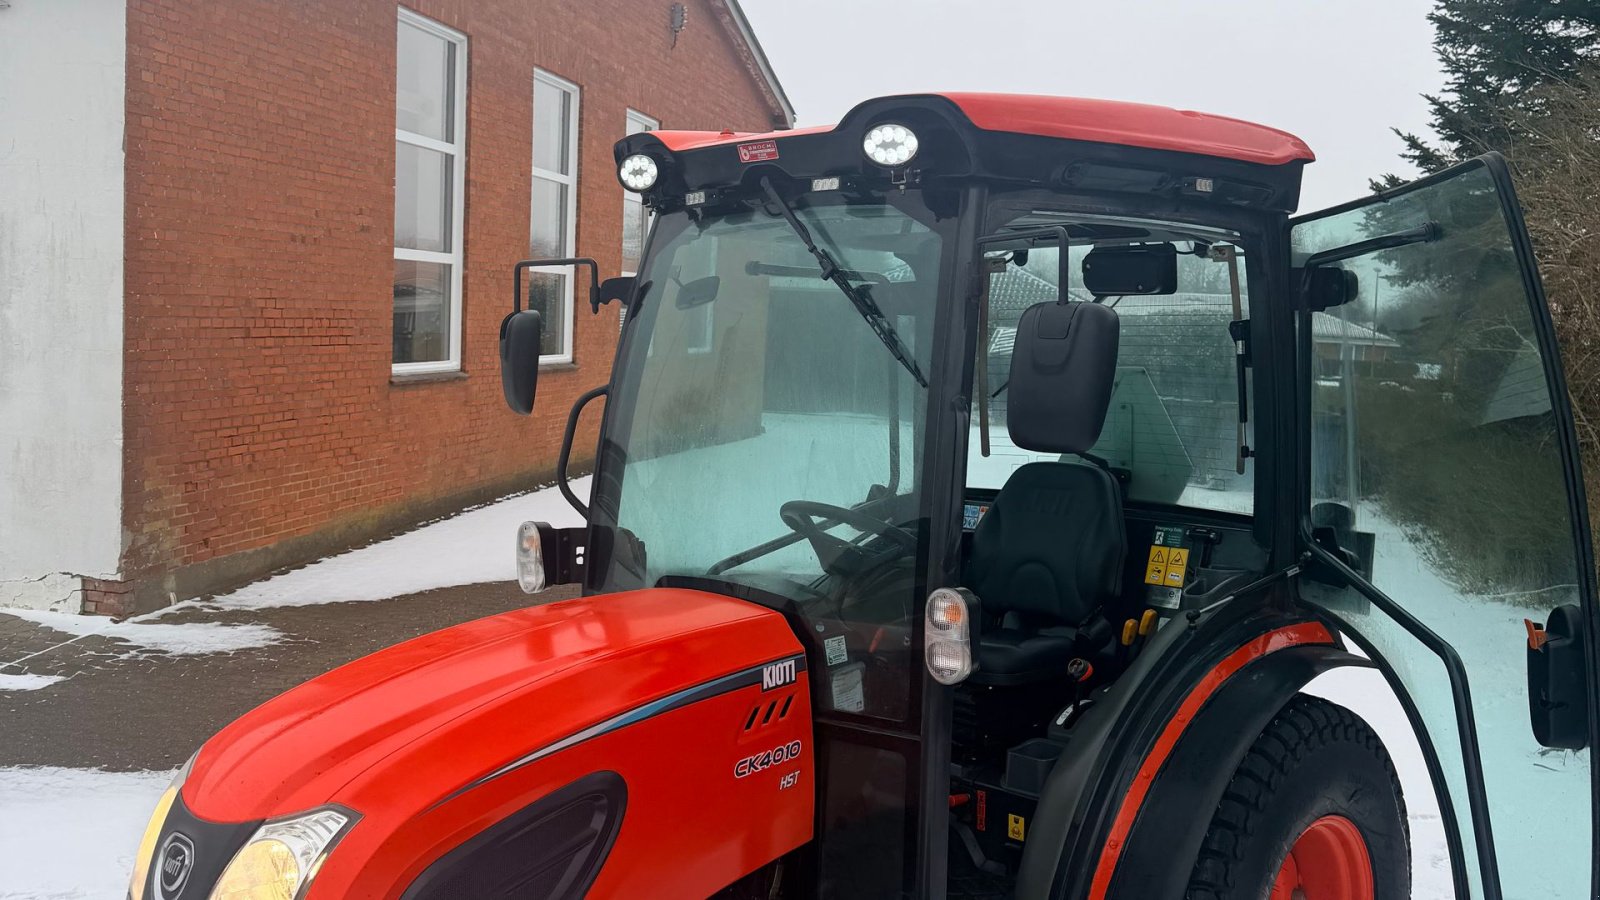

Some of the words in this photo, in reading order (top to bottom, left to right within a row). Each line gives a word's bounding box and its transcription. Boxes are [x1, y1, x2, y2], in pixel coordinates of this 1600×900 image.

[763, 660, 796, 690] KIOTI
[734, 740, 801, 778] CK4010
[780, 771, 800, 790] HST
